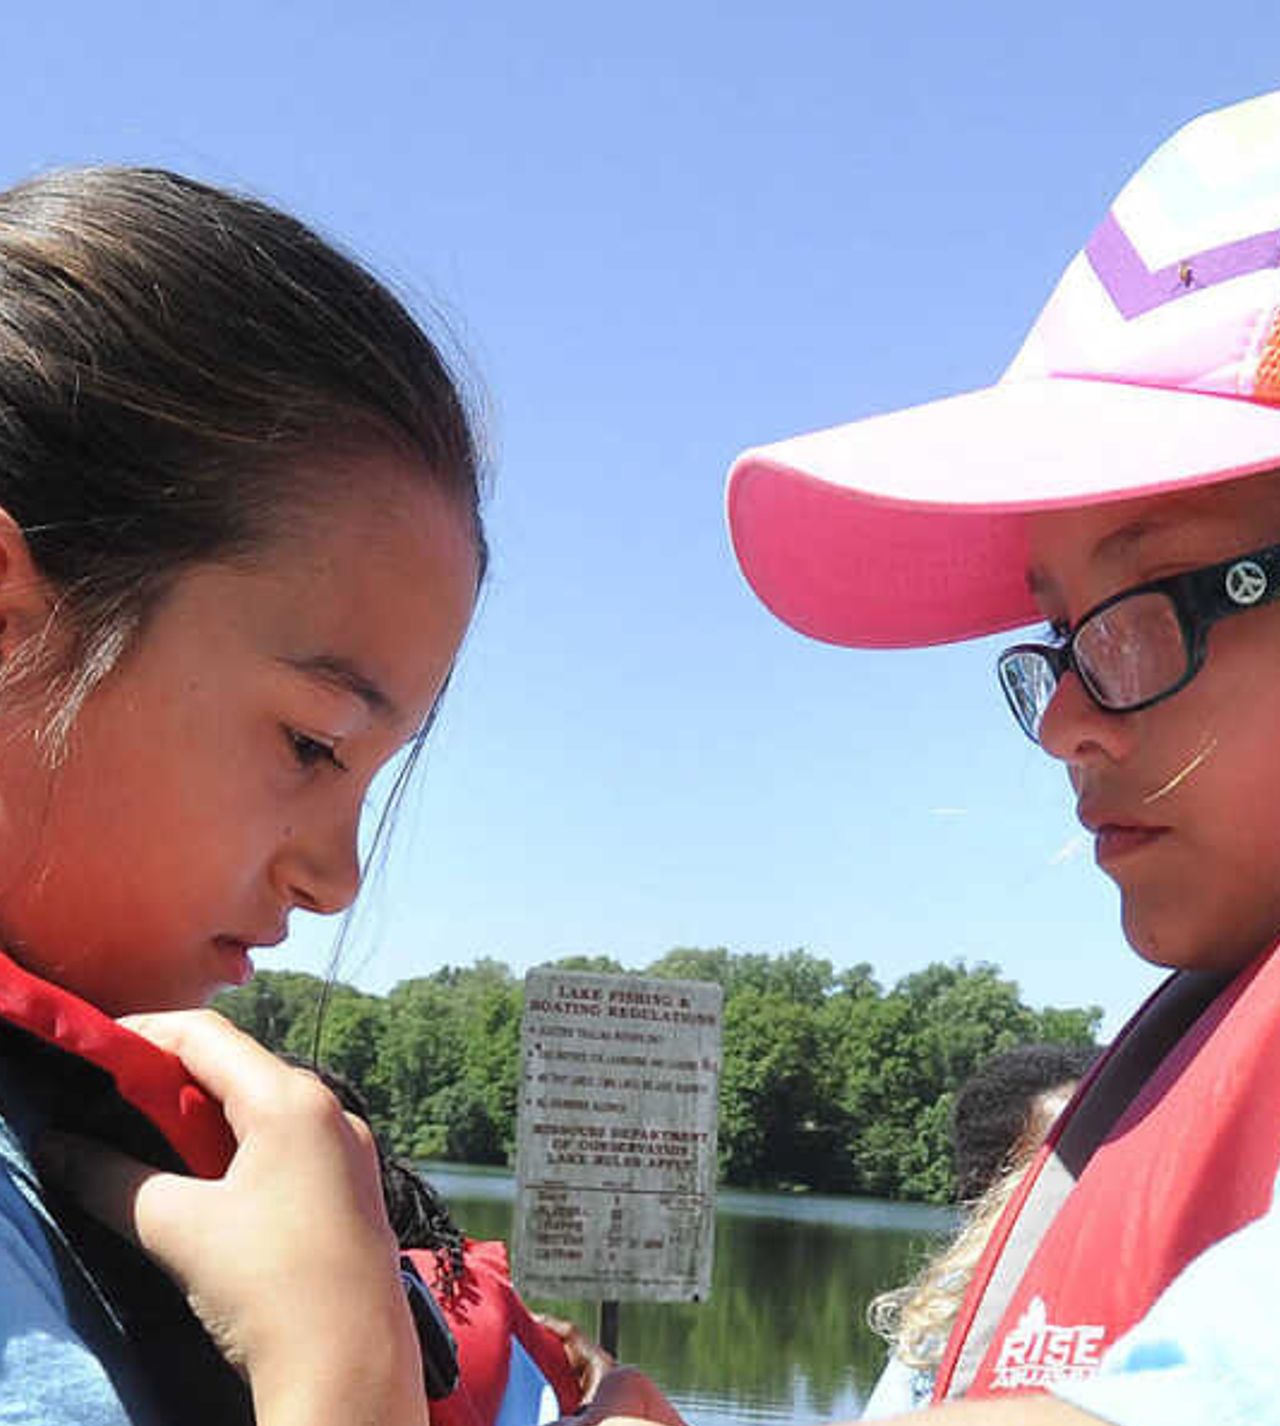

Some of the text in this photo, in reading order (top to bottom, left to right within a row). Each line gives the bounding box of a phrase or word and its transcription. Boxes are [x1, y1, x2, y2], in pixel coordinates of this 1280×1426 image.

[558, 985, 602, 1000] LAKE
[609, 990, 672, 1007] FISHING
[529, 999, 716, 1026] BOATING REGULATIONS
[997, 1303, 1107, 1367] RISE
